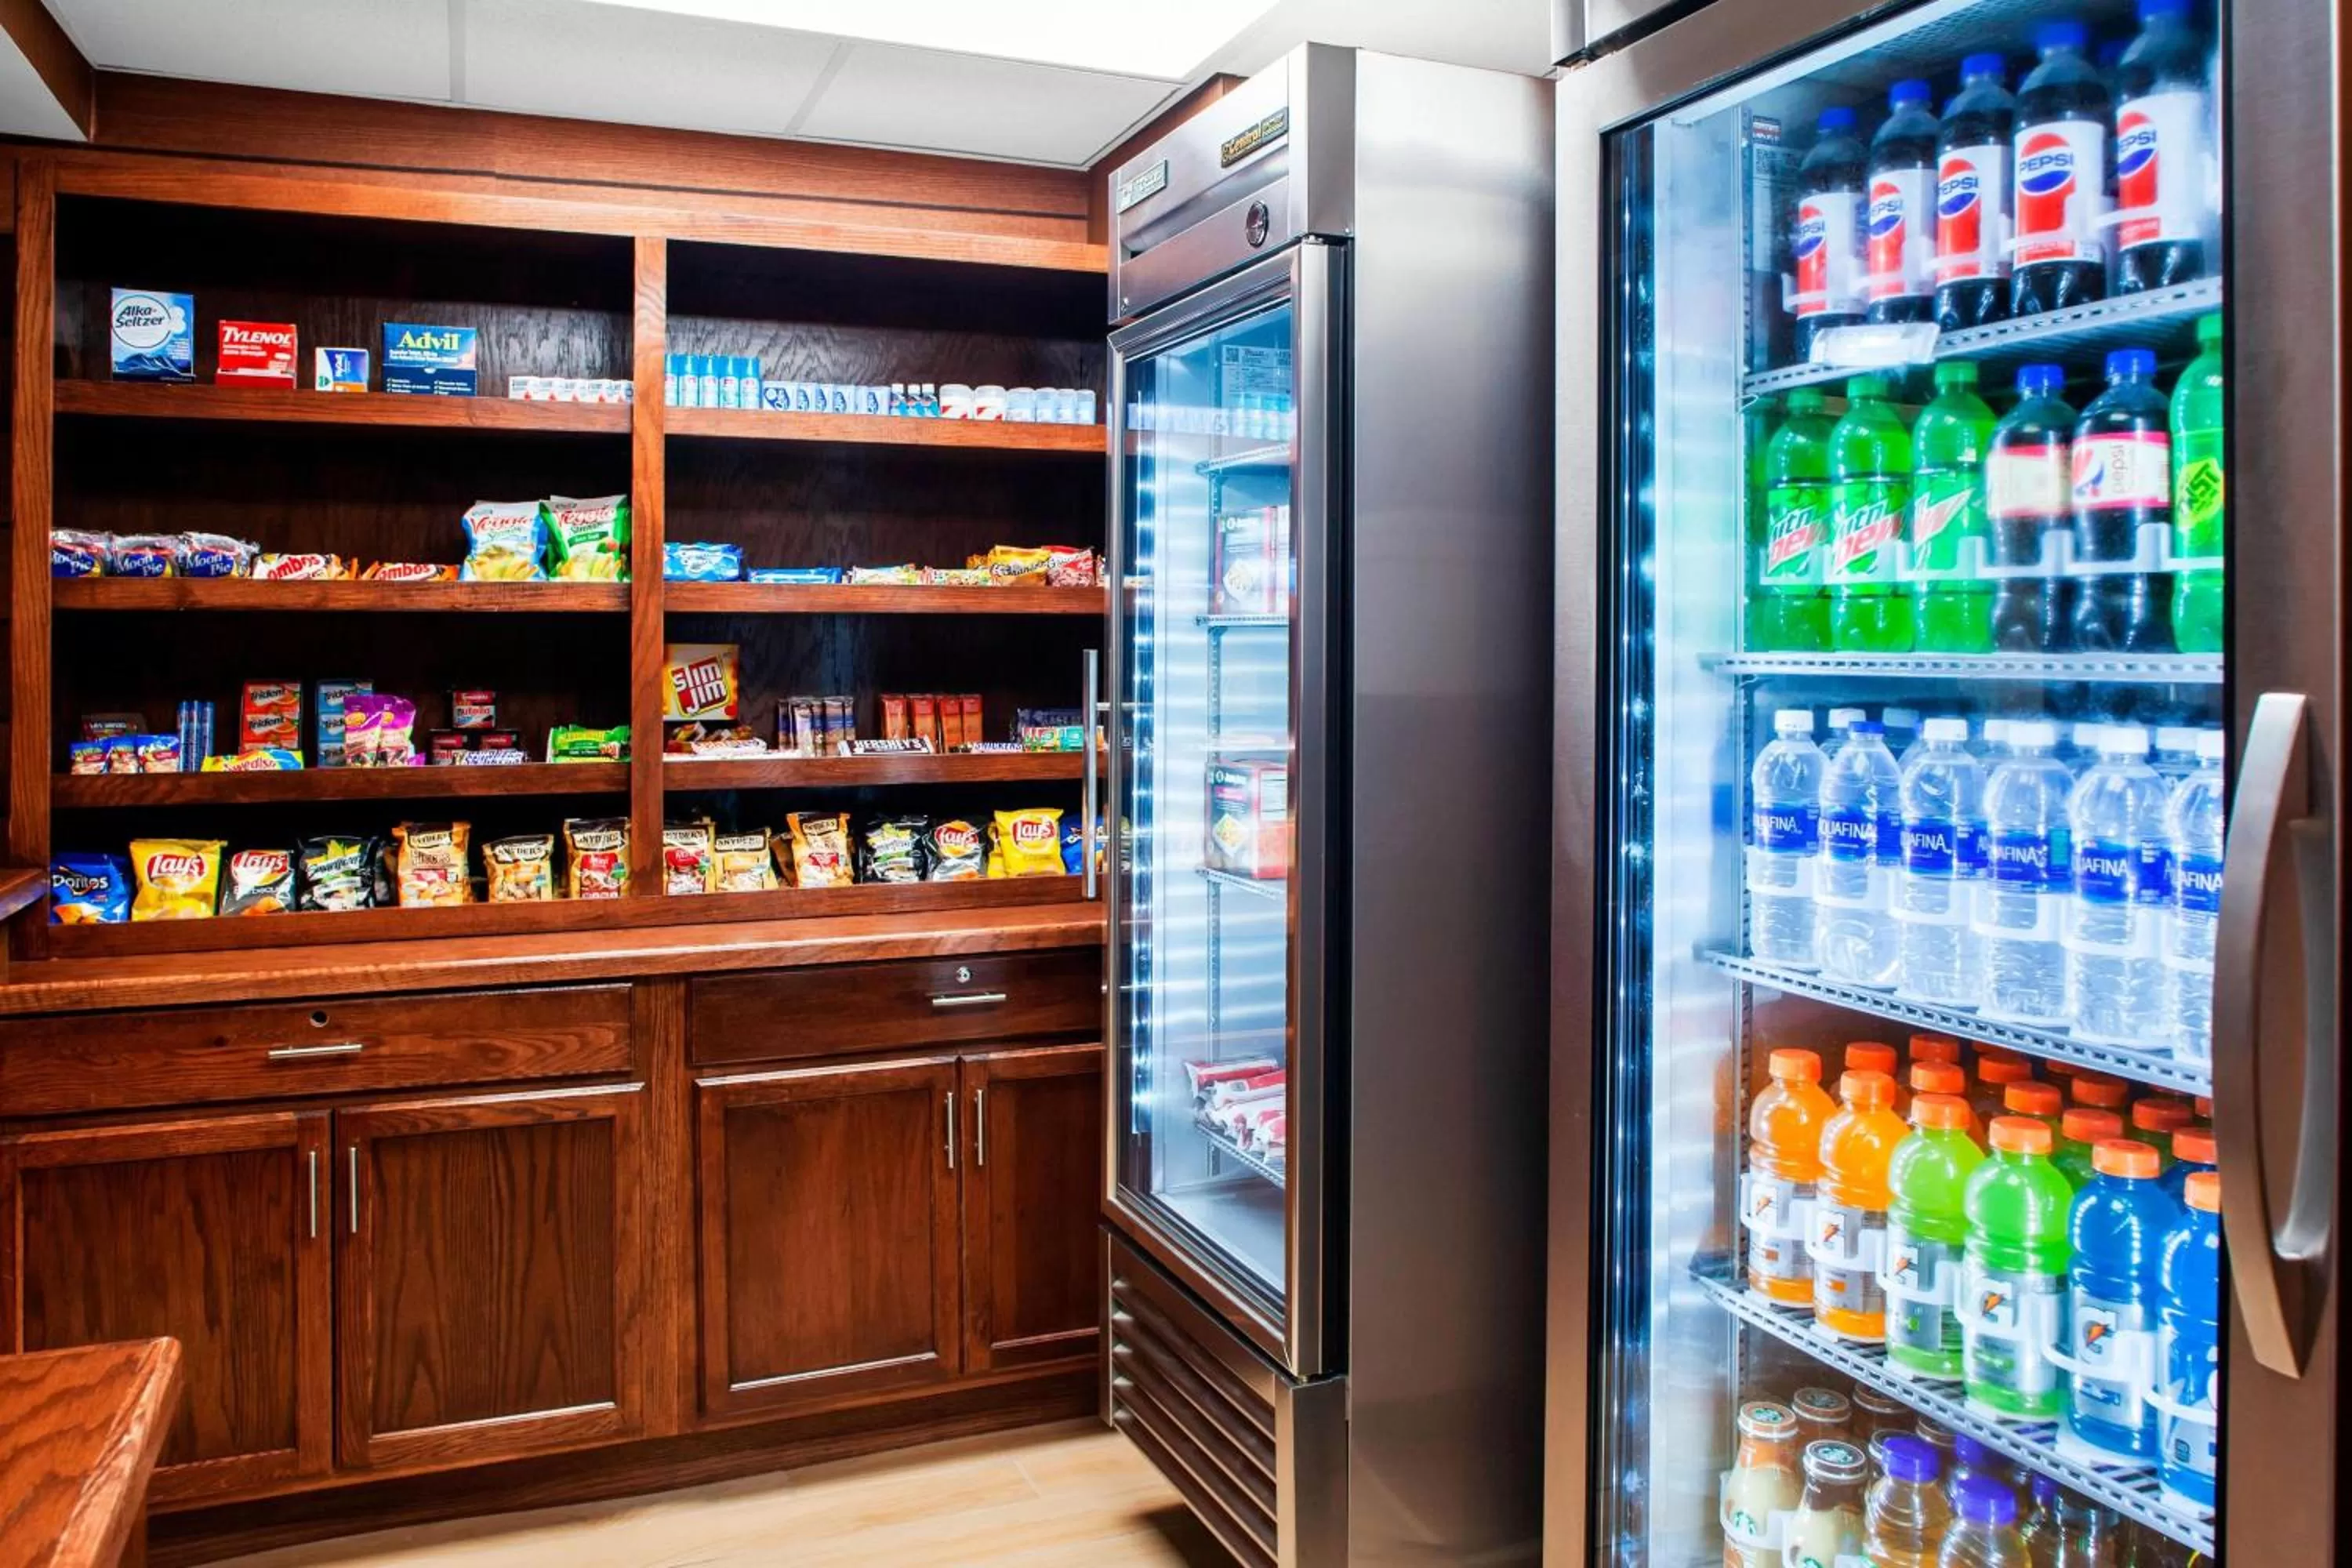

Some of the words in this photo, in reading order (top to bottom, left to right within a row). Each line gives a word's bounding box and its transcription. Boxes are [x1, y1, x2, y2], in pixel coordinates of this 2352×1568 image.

[2118, 129, 2157, 152] EPSI
[2019, 154, 2074, 172] PEPSI
[1871, 198, 1904, 214] EPSI
[121, 305, 157, 317] Alka-
[115, 315, 165, 328] Seltzer
[222, 326, 292, 345] TYLENOL
[397, 330, 461, 350] Advil
[267, 556, 321, 579] ombos
[379, 564, 430, 579] ombos
[1014, 821, 1051, 840] Lay's
[1818, 818, 1876, 840] QUAFINA
[151, 852, 201, 879] Lay's
[238, 851, 285, 870] Lay's
[52, 874, 109, 890] Doritos
